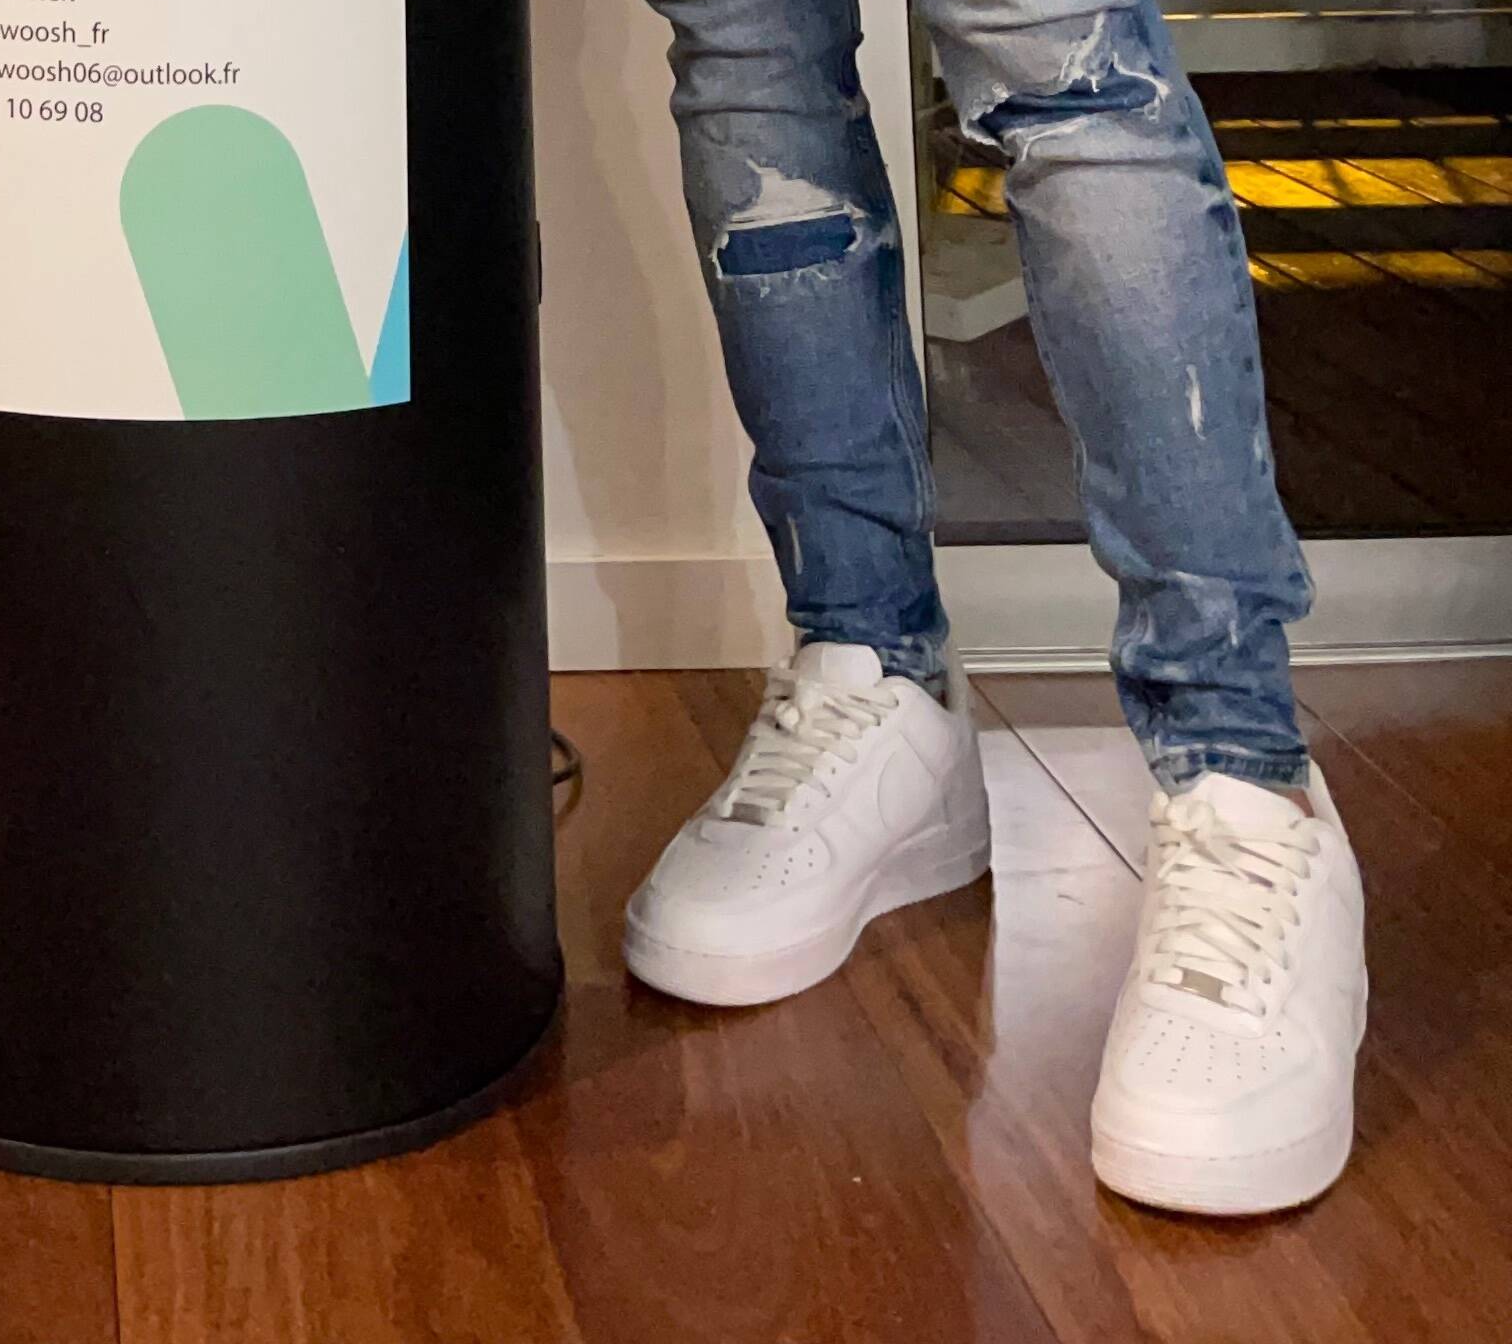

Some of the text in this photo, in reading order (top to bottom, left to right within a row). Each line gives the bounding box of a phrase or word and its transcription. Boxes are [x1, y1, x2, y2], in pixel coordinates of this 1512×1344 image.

[7, 97, 33, 120] 10
[39, 99, 68, 122] 69
[74, 101, 104, 124] 08
